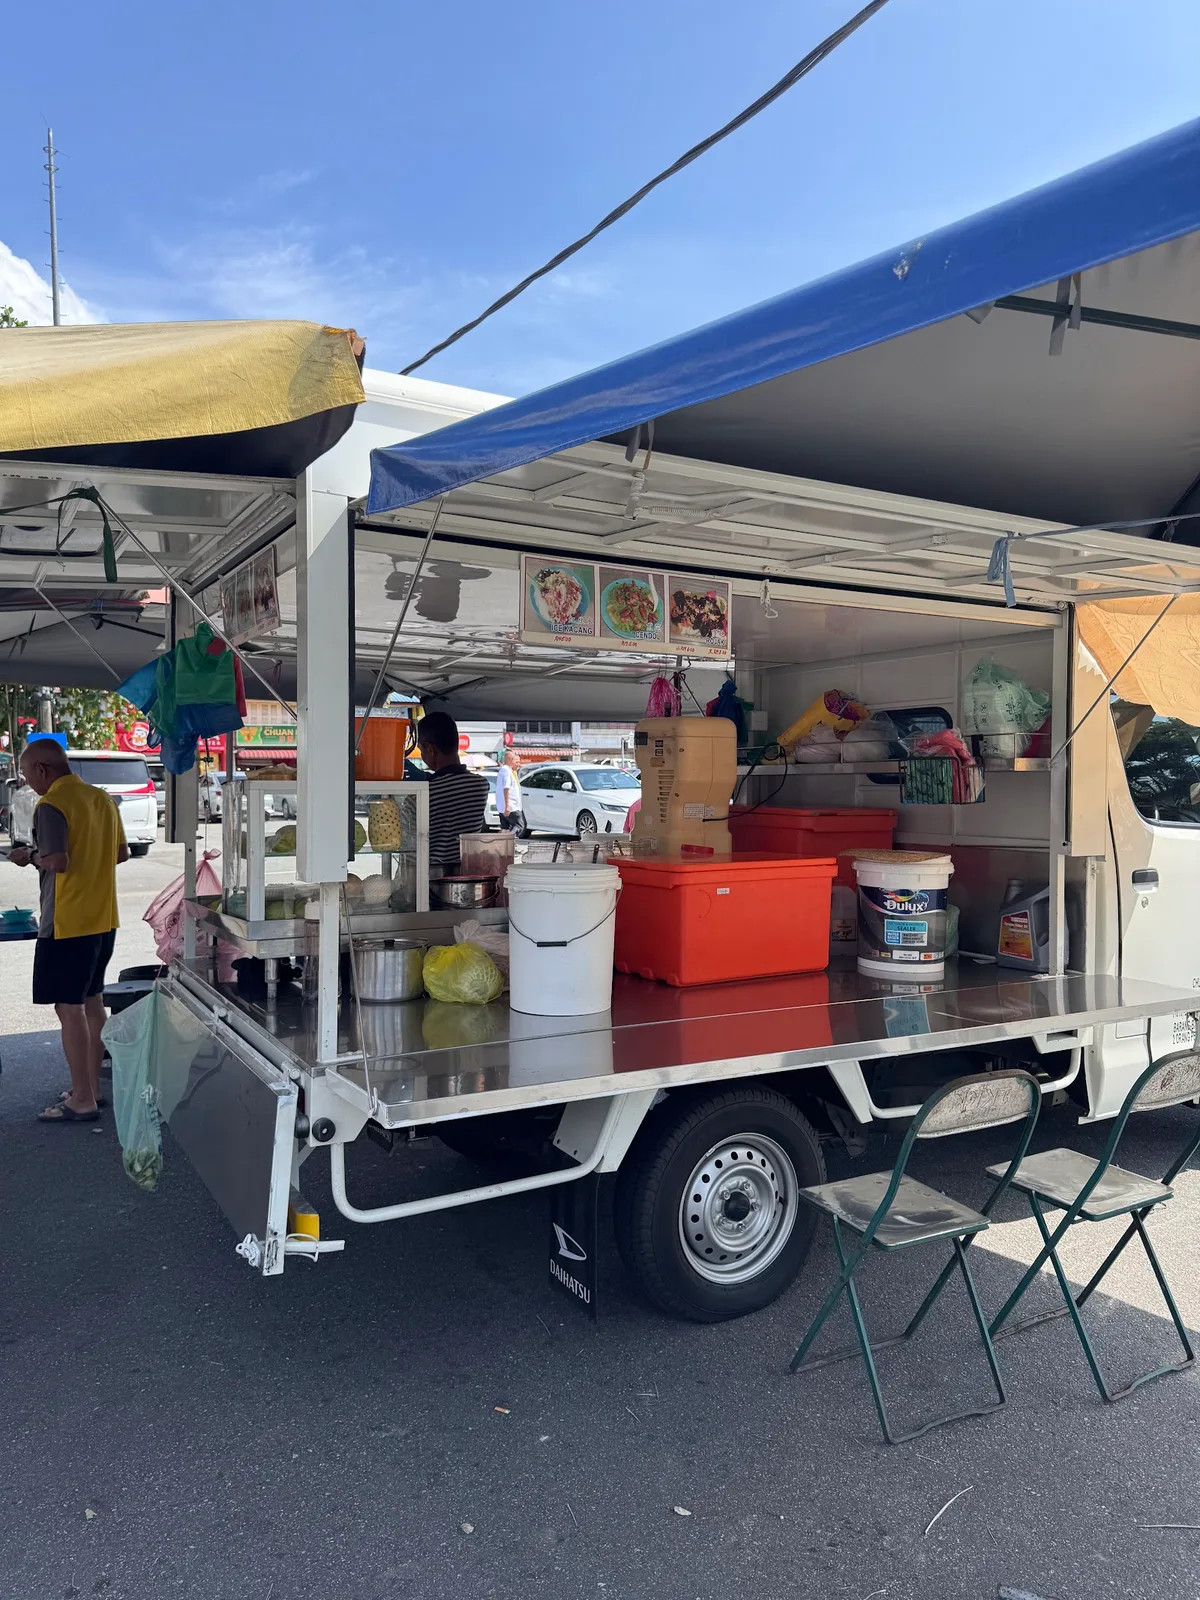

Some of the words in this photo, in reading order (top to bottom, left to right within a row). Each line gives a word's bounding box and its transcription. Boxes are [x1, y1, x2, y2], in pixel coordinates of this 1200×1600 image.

[551, 624, 563, 632] ICE
[563, 625, 593, 635] KACANG
[886, 900, 924, 911] Dulux
[550, 1258, 590, 1304] DAIHATSU
